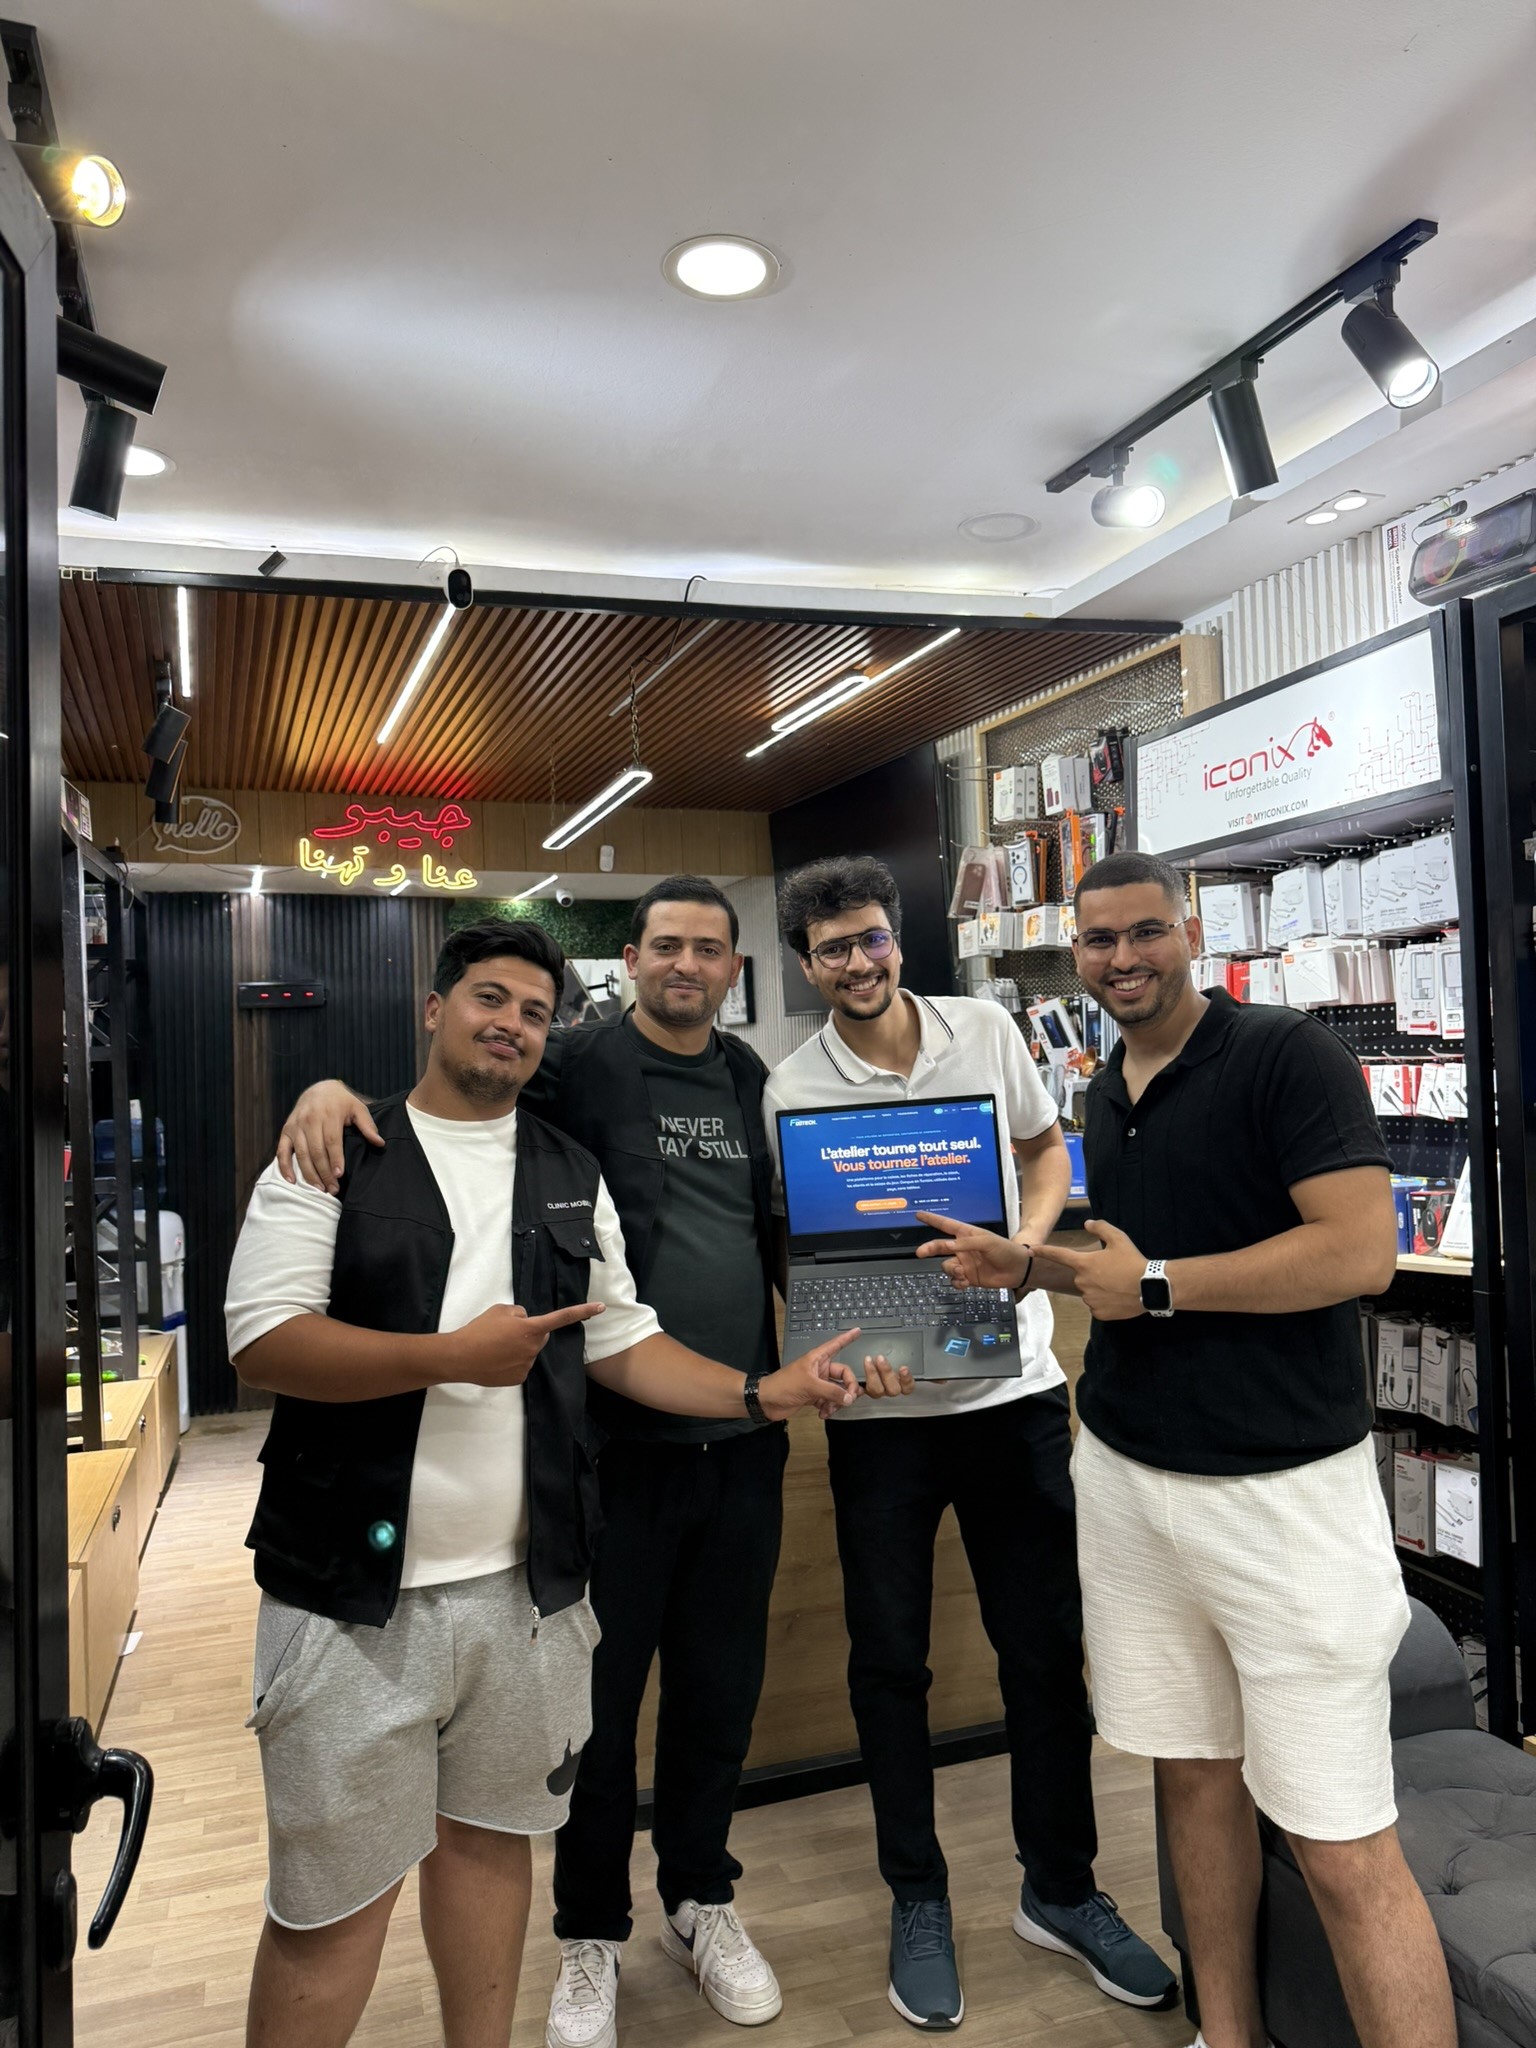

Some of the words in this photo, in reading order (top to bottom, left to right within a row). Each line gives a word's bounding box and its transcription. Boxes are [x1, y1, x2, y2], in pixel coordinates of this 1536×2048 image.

[1203, 737, 1296, 791] iconix
[1224, 776, 1280, 802] Unforgettable
[1281, 767, 1313, 785] Quality
[1227, 816, 1245, 829] VISIT
[1253, 799, 1309, 821] MYICONIX.COM
[373, 864, 407, 887] و
[422, 854, 478, 890] عنا
[659, 1114, 724, 1137] NEVER
[656, 1136, 693, 1158] TAY
[698, 1140, 748, 1159] STILL
[820, 1144, 871, 1160] L'atelier
[872, 1141, 916, 1155] tourne
[918, 1140, 948, 1153] tout
[950, 1137, 982, 1150] seul.
[833, 1159, 866, 1173] Vous
[868, 1155, 919, 1171] tournez
[920, 1152, 971, 1167] l'atelier.
[547, 1202, 570, 1210] CLINIC
